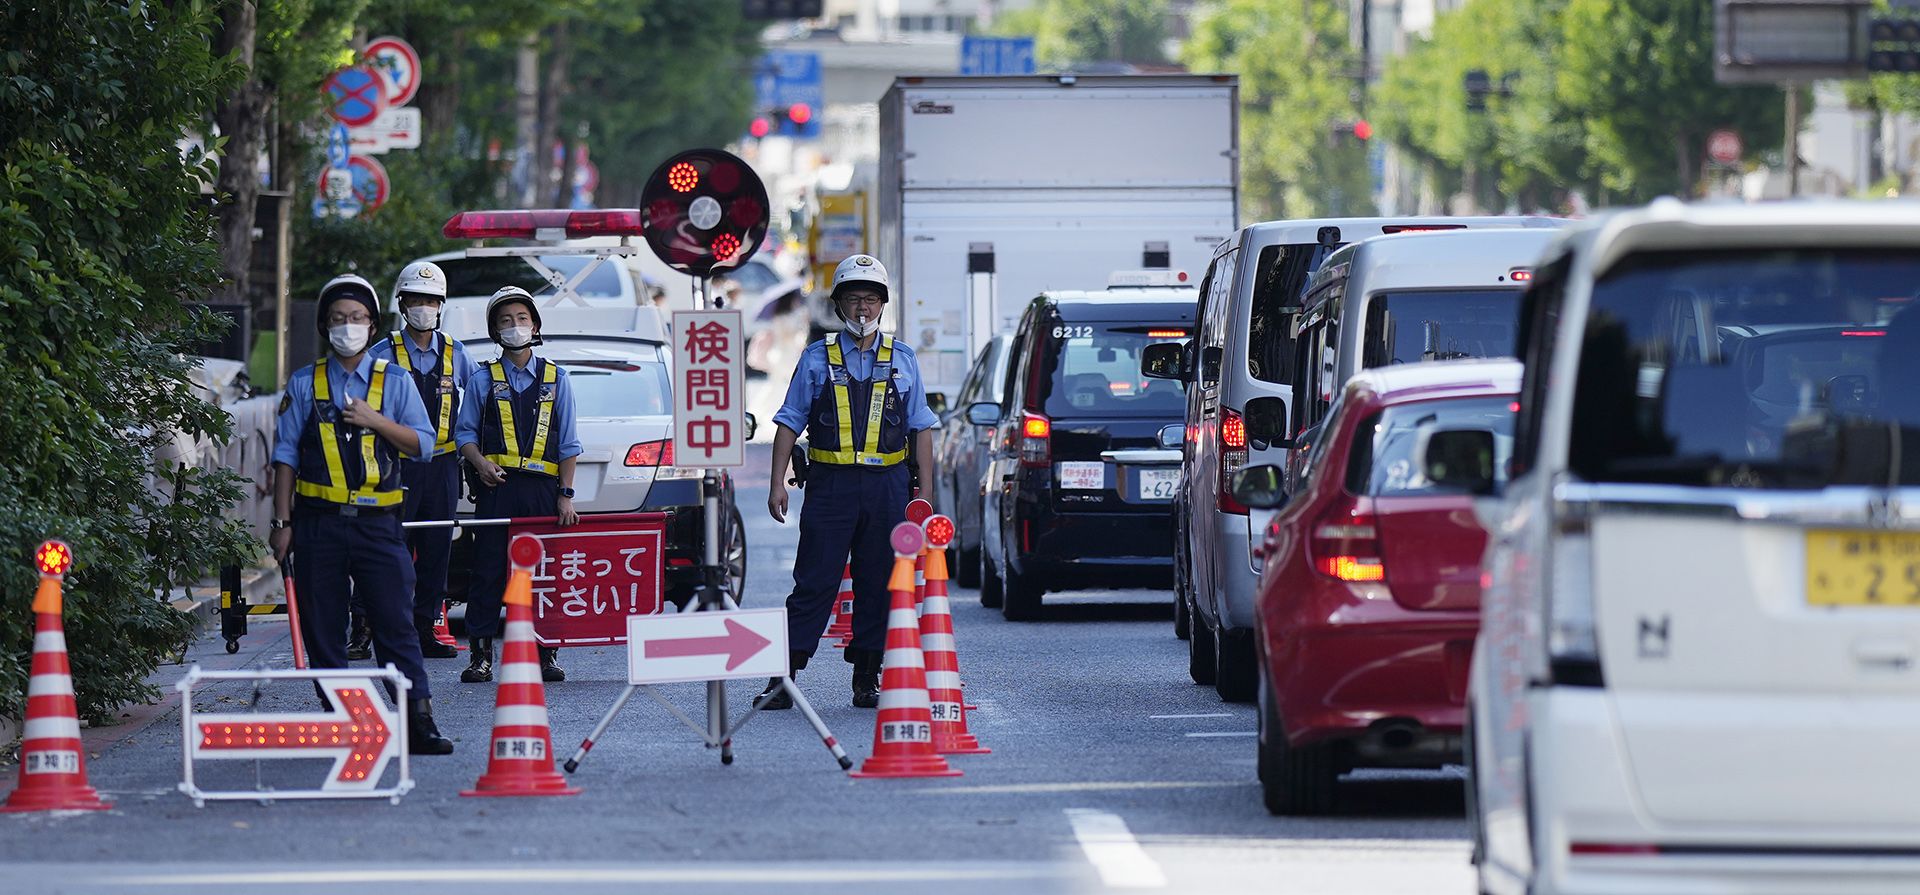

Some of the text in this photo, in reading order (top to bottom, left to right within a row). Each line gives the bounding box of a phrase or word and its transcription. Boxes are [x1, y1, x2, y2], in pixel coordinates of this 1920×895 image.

[1052, 326, 1093, 338] 6212
[685, 321, 731, 459] 検問中
[870, 393, 883, 421] 警視庁
[531, 547, 647, 580] 止まって
[531, 583, 638, 618] 下さい!
[931, 703, 961, 720] 視庁
[883, 724, 931, 742] 警視庁
[496, 740, 544, 758] 警視庁
[27, 753, 77, 772] 警視庁
